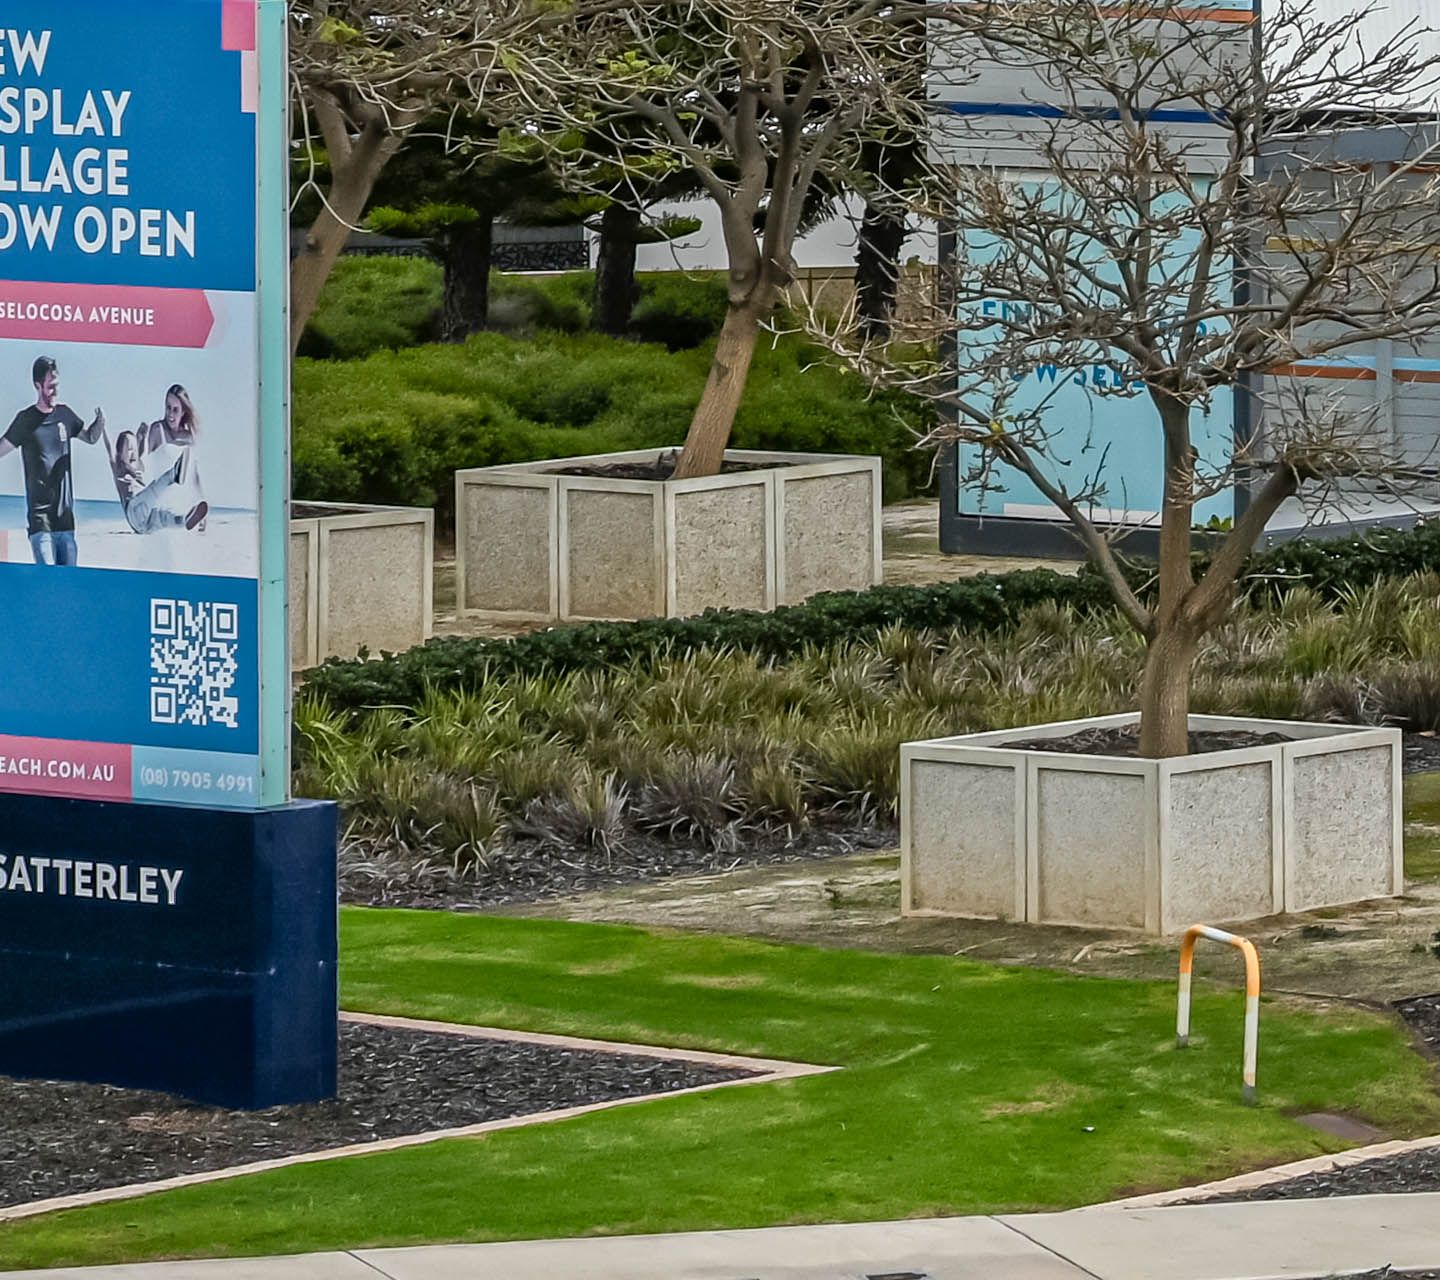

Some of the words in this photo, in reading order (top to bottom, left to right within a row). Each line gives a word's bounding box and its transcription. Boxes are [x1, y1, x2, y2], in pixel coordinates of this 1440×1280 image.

[0, 86, 132, 137] SPLAY
[0, 144, 129, 197] LLAGE
[73, 205, 196, 259] OPEN
[88, 305, 155, 327] AVENUE
[139, 765, 169, 788] (08)
[172, 769, 213, 790] 7905
[216, 773, 254, 794] 4991
[0, 853, 185, 906] SATTERLEY
